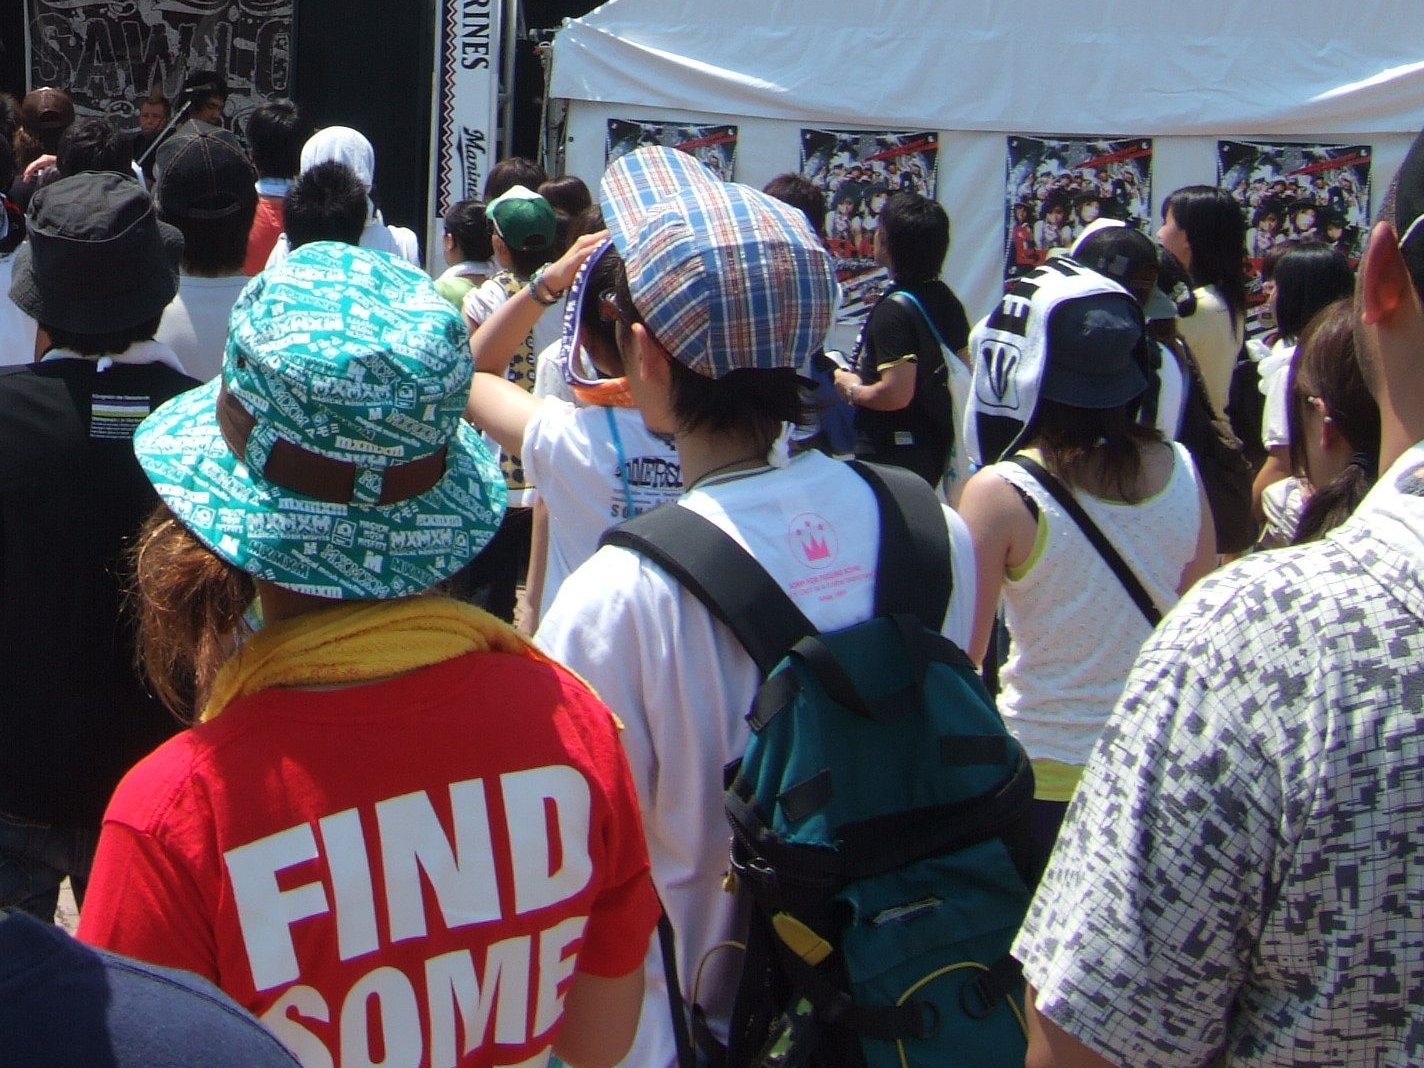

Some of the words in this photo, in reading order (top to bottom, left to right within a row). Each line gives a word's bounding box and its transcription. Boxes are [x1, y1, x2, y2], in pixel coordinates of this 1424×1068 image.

[457, 124, 486, 202] Marine
[223, 765, 593, 993] FIND
[258, 915, 589, 1068] SOME
